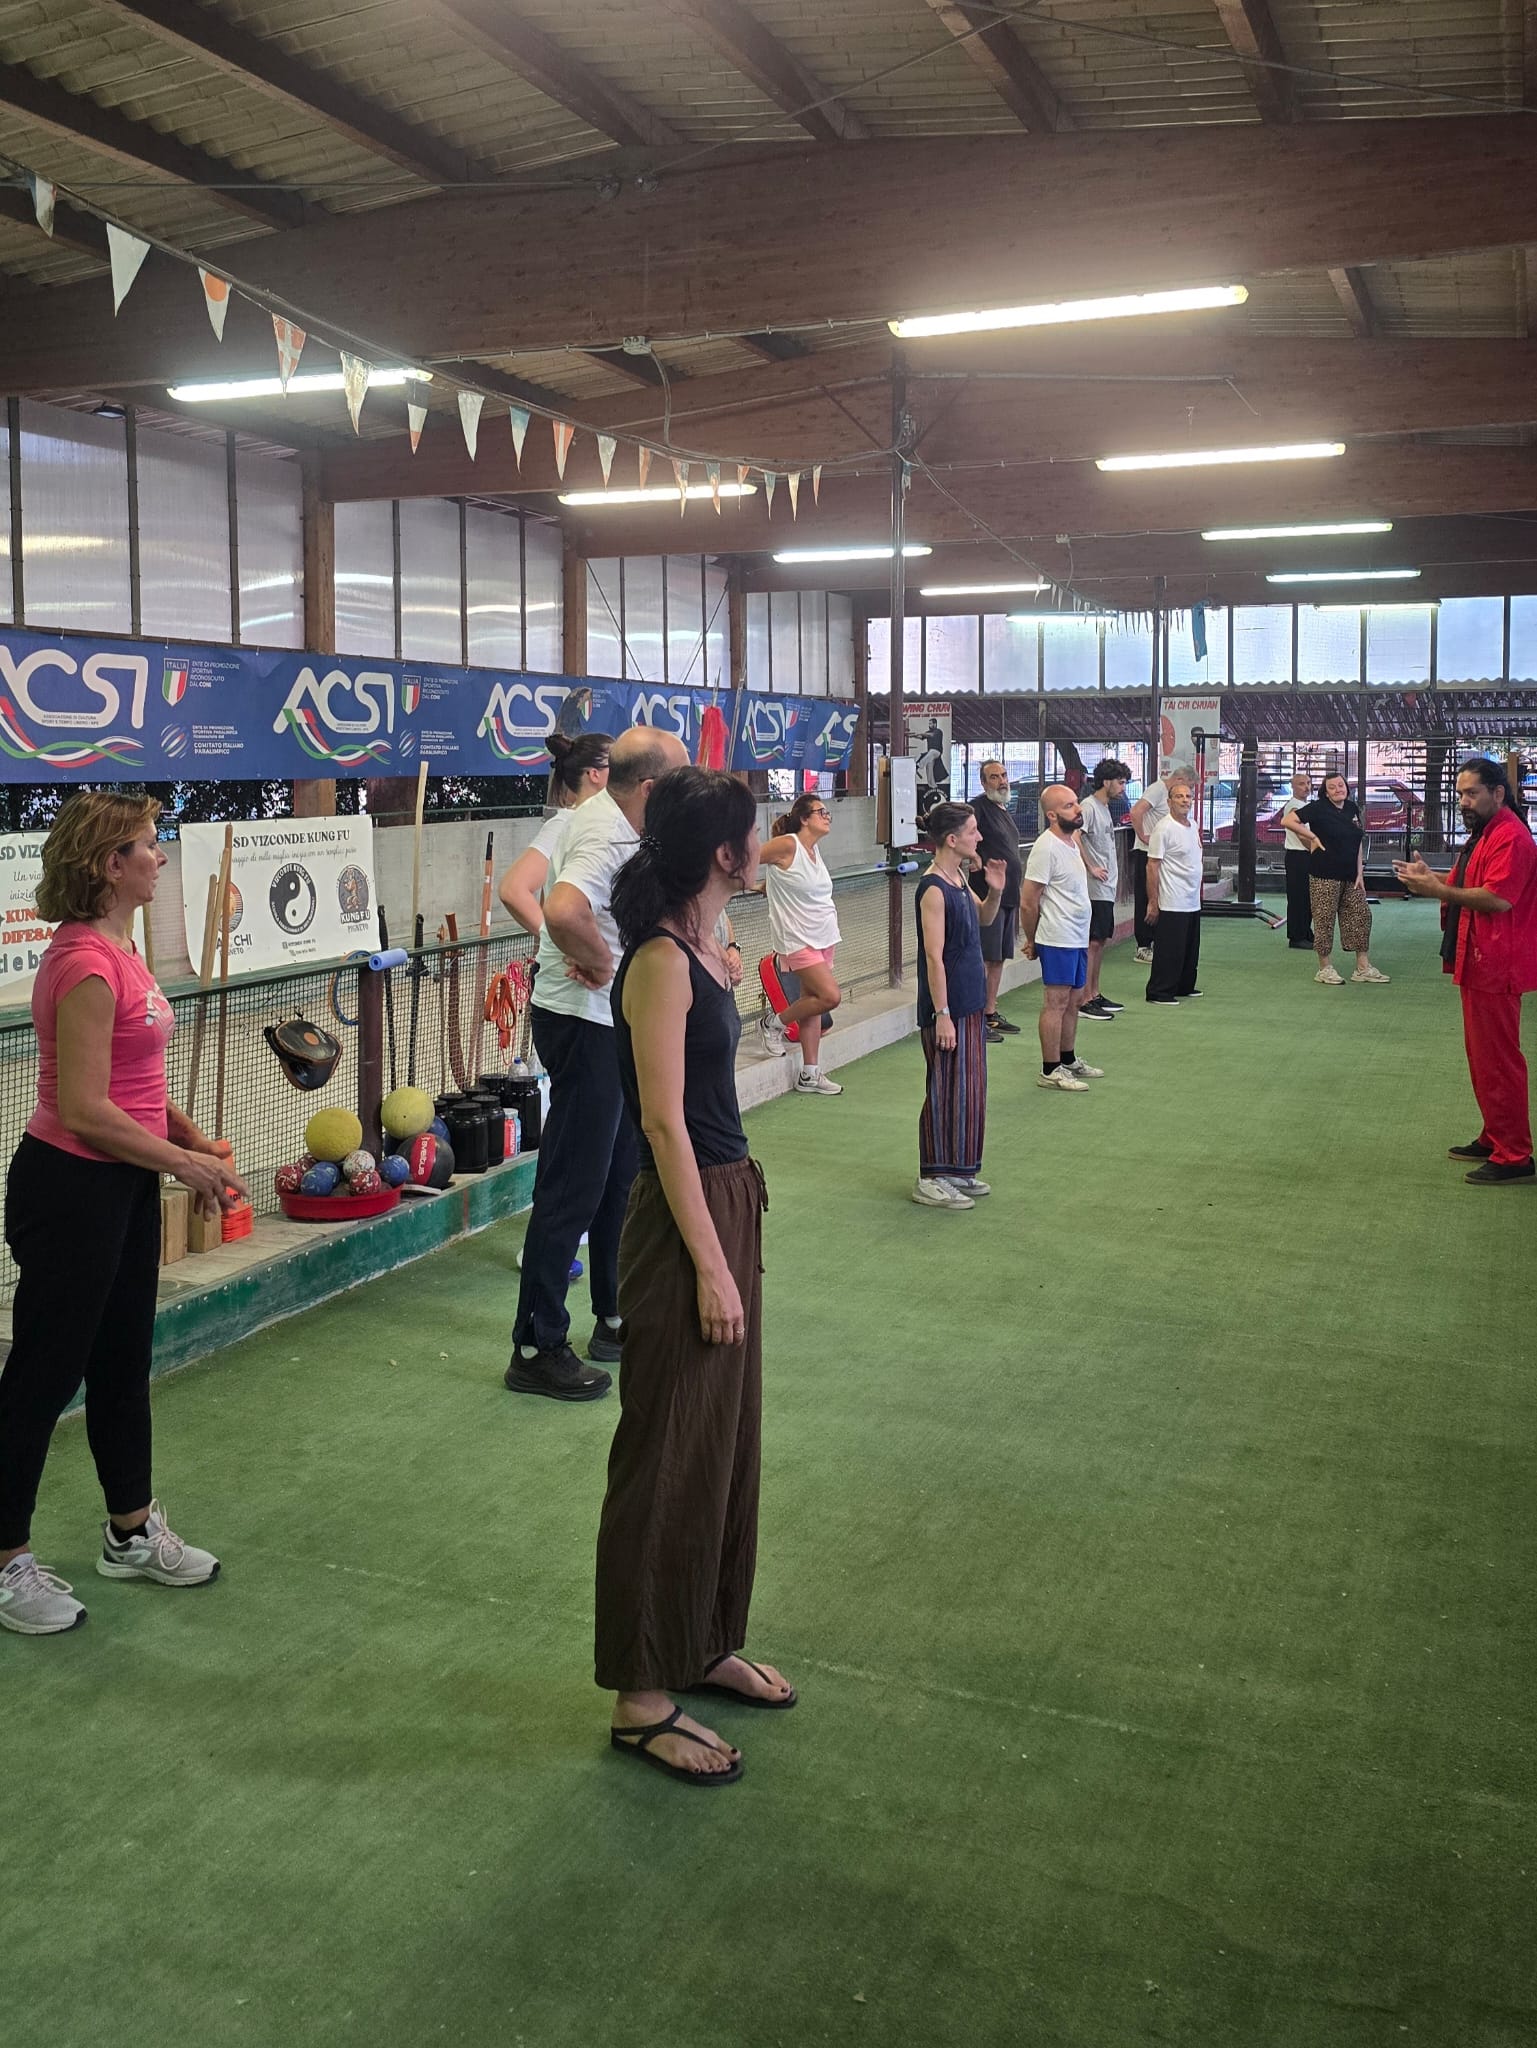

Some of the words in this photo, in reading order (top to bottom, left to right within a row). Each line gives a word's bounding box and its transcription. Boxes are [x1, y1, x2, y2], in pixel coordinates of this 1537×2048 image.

[166, 661, 187, 670] ITALIA
[273, 667, 395, 734] ACSI
[1164, 701, 1176, 710] TAI
[1178, 701, 1190, 710] CHI
[1191, 701, 1218, 710] CHUAN
[902, 704, 925, 712] WING
[927, 704, 951, 712] CHUN
[250, 832, 305, 847] VIZCONDE
[306, 830, 335, 843] KUNG
[337, 830, 350, 841] FU
[13, 872, 27, 882] Un
[341, 911, 360, 922] KUNG
[361, 910, 370, 920] FU
[348, 924, 369, 933] PIGNETO
[2, 927, 54, 944] DIFESA
[234, 933, 252, 947] CHI
[13, 955, 23, 971] e
